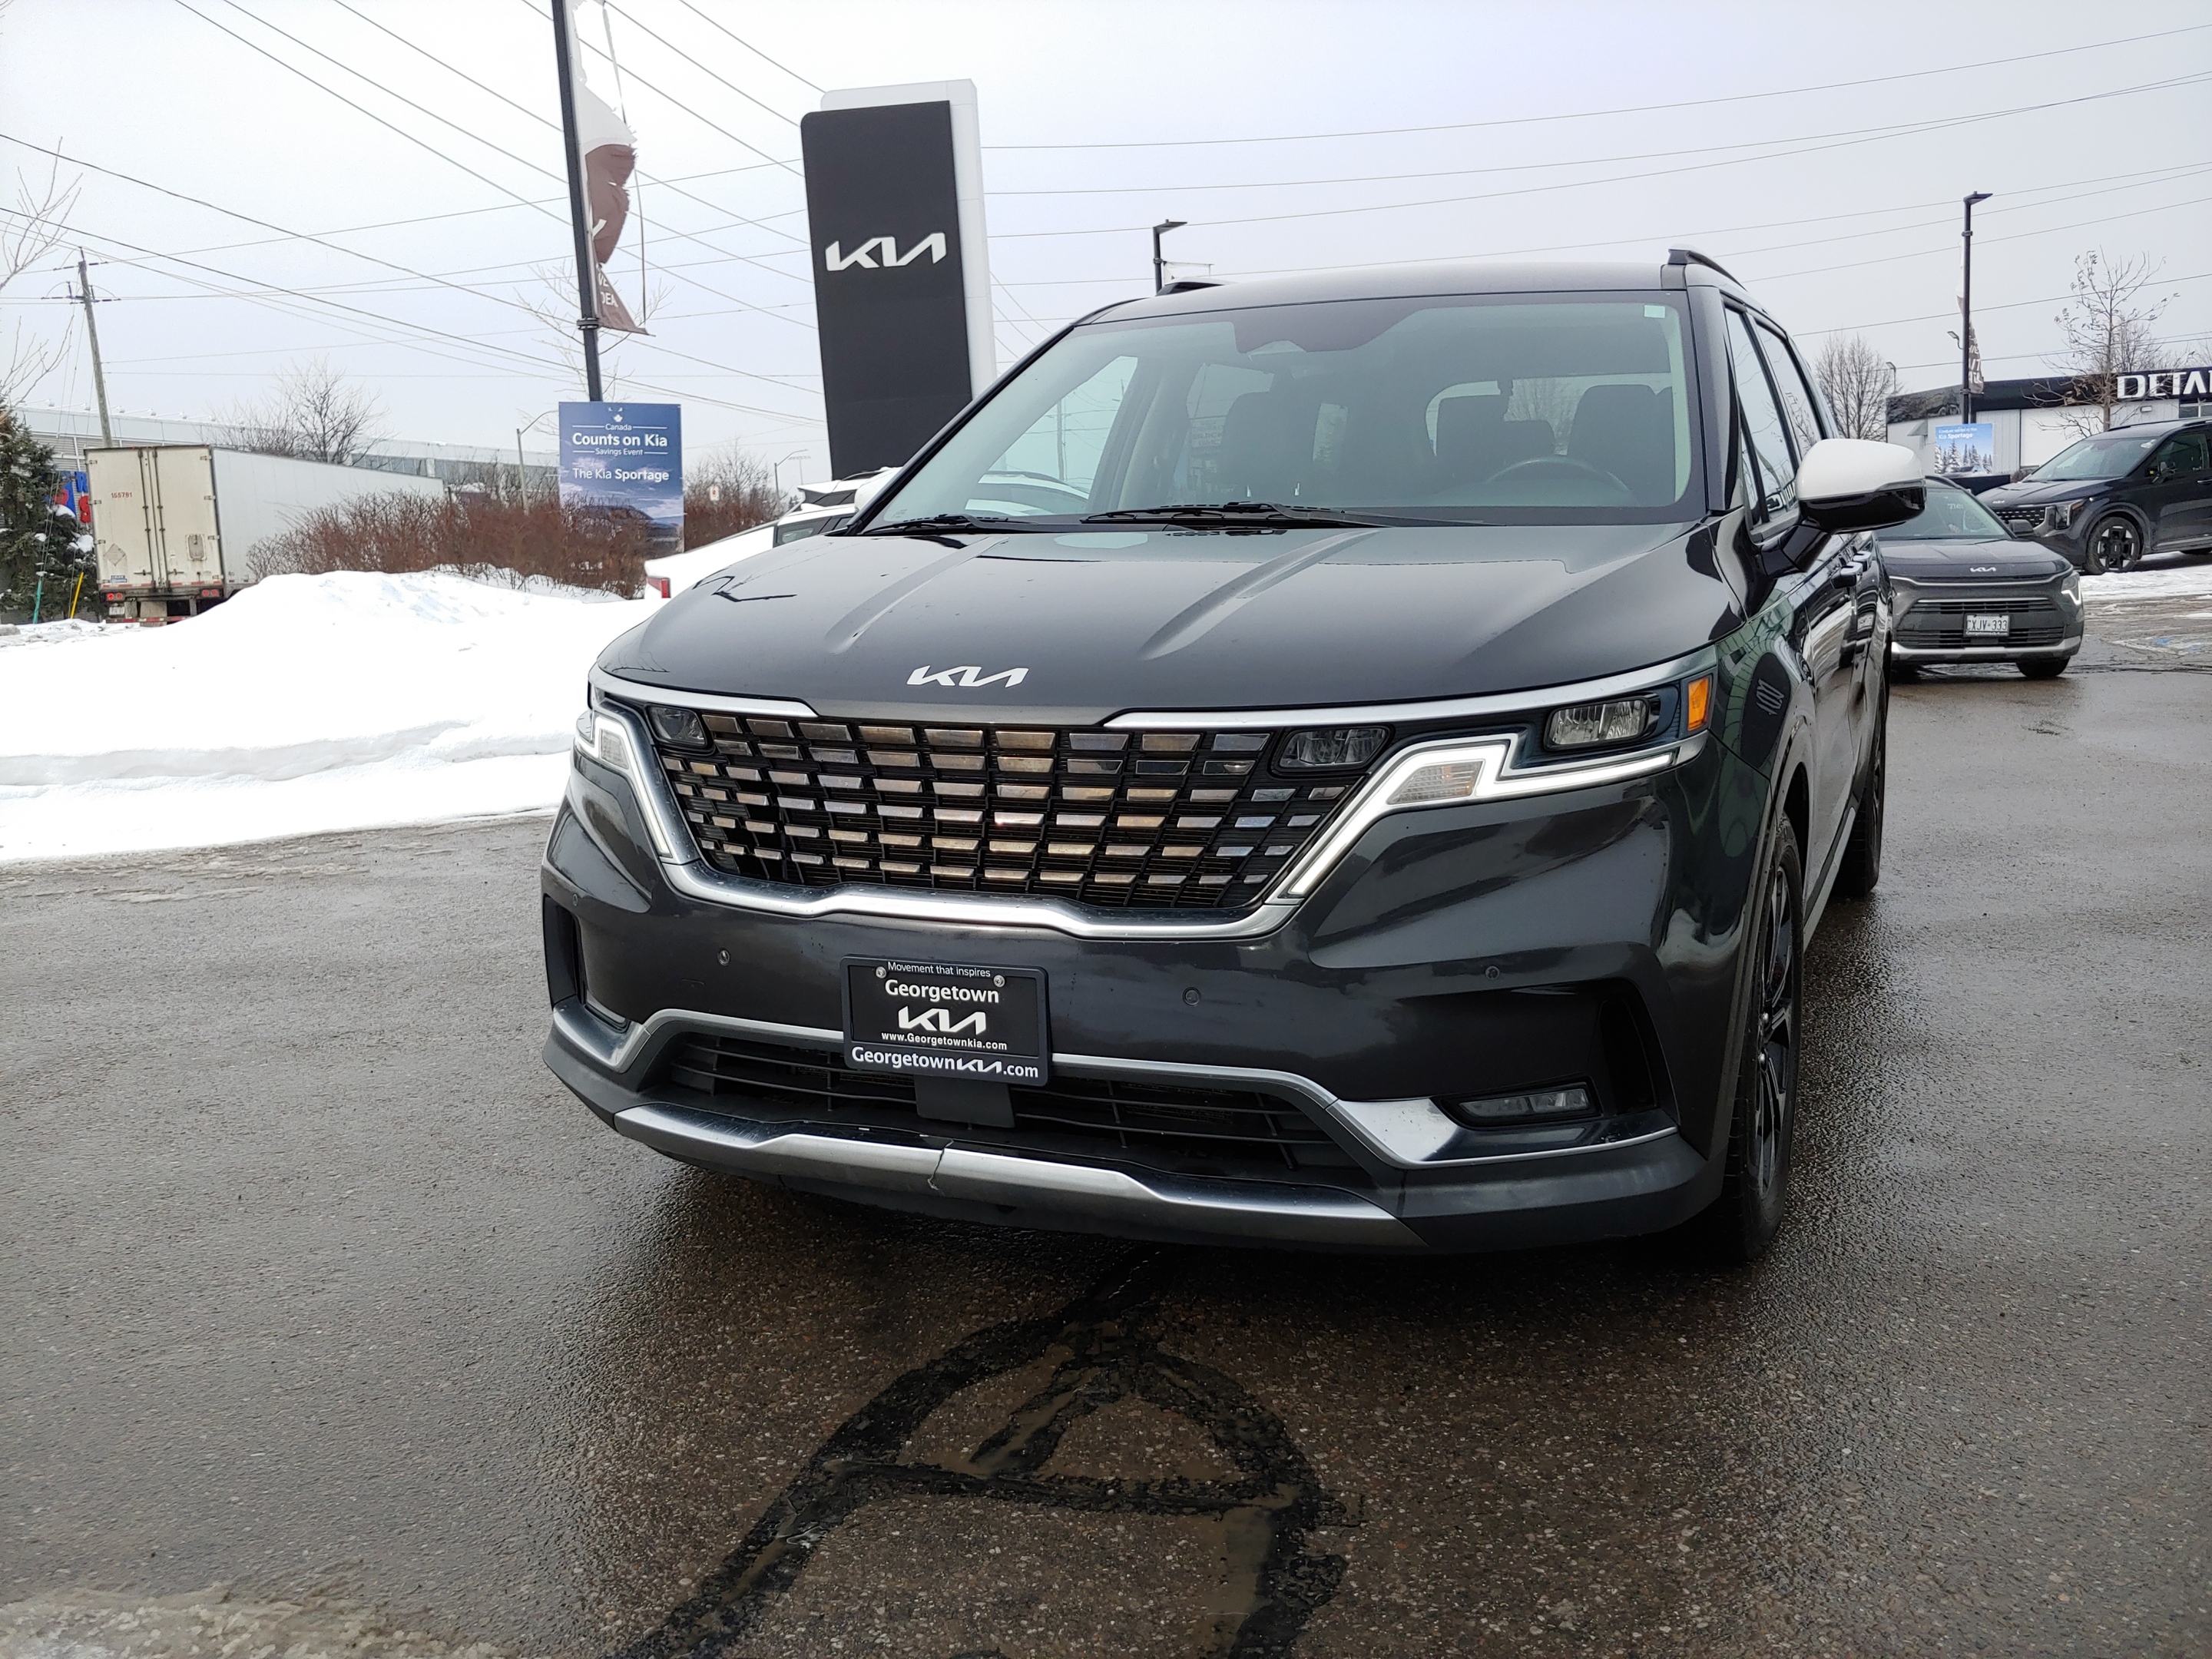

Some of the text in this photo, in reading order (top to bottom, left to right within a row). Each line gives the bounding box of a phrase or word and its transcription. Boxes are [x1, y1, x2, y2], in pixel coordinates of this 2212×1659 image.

[825, 231, 947, 272] KIA
[604, 422, 633, 431] Canada
[571, 432, 668, 447] Counts on Kia
[595, 447, 622, 457] Savings
[573, 468, 671, 483] The Kia Sportage
[1991, 619, 2008, 631] 333
[906, 664, 1029, 688] KIA
[887, 961, 991, 978] Movement that inspires
[884, 979, 1000, 1004] Georgetown
[897, 1005, 987, 1036] KIA
[881, 1031, 1008, 1051] www.Georgetownkia.com
